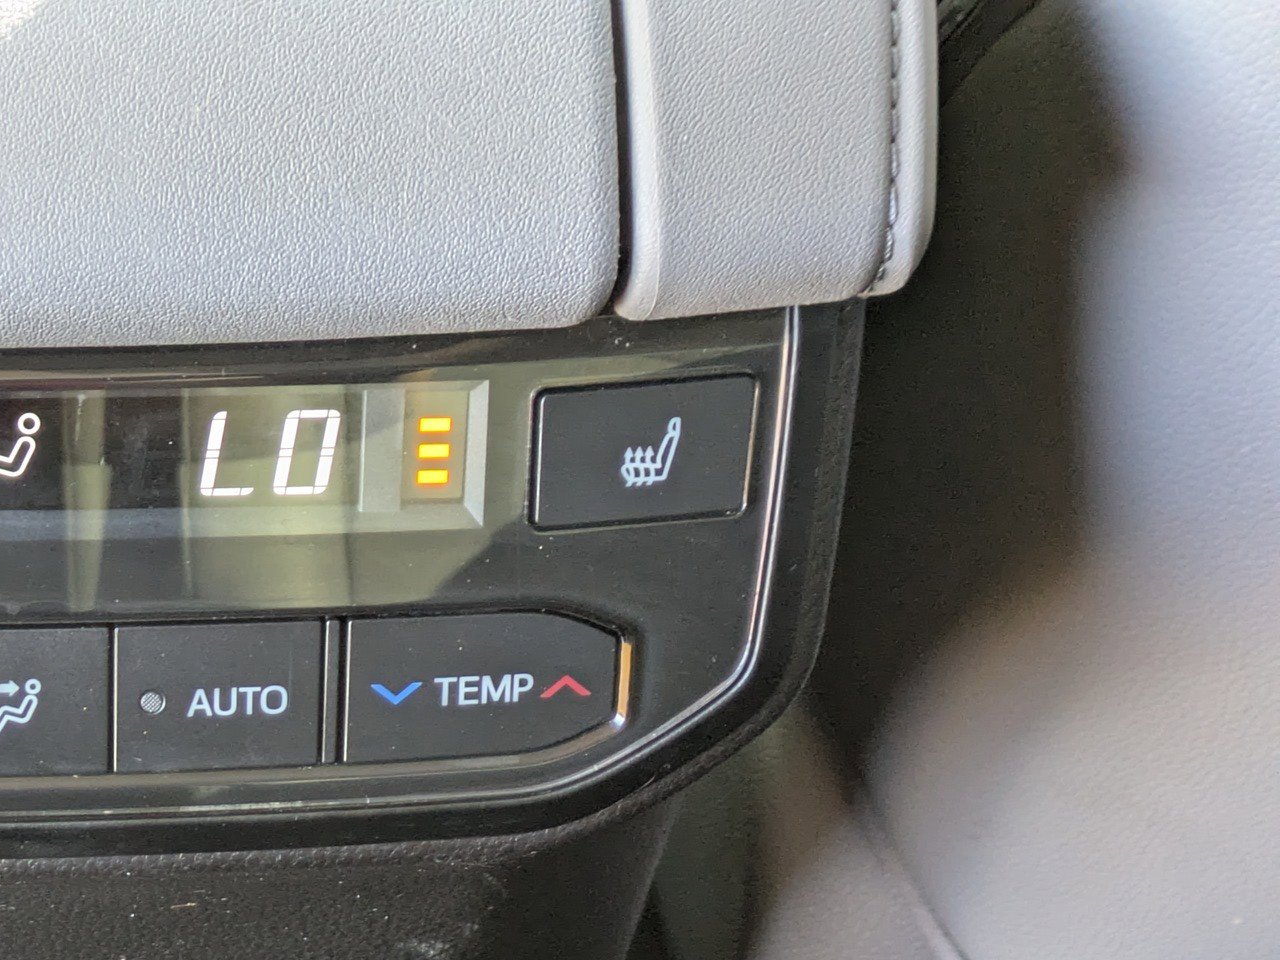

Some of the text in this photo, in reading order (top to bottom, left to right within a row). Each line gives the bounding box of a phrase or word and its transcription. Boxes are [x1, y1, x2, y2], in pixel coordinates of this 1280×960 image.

[199, 409, 341, 496] LO
[187, 685, 289, 718] AUTO
[434, 673, 535, 707] TEMP
